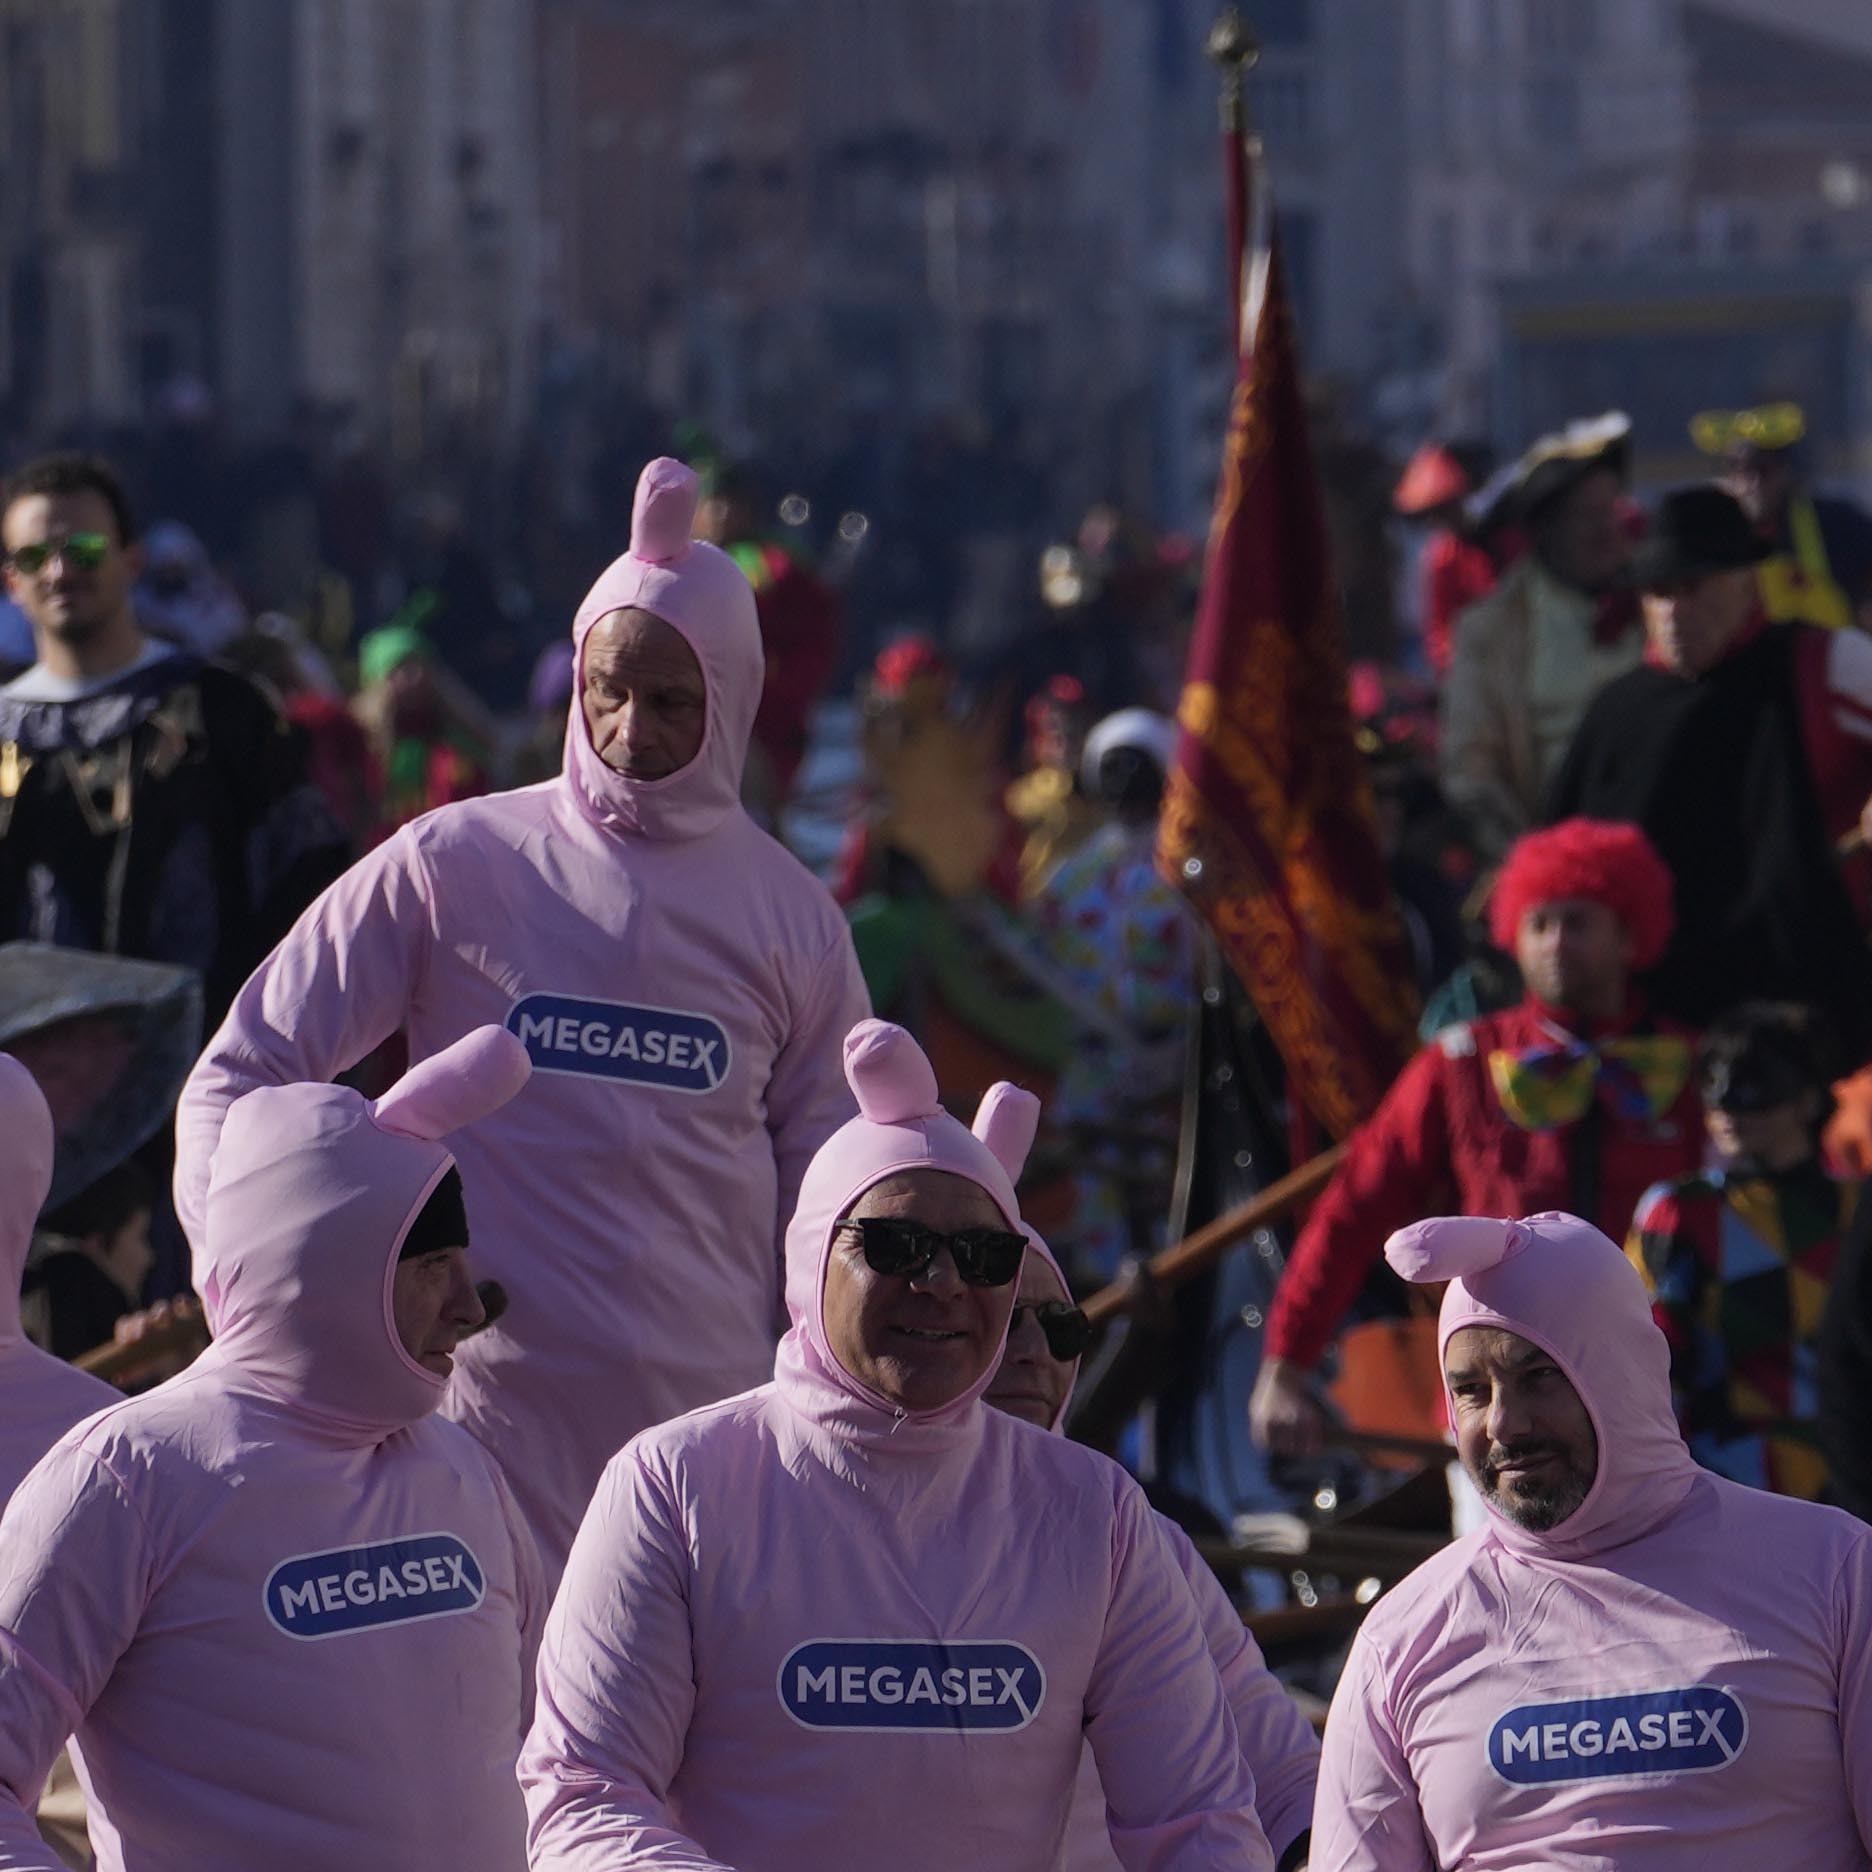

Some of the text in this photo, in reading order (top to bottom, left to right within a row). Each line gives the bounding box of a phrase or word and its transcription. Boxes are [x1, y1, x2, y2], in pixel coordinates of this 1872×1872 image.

[518, 1012, 720, 1088] MEGASEX
[279, 1554, 482, 1619] MEGASEX
[796, 1665, 1033, 1719] MEGASEX
[1501, 1707, 1735, 1765] MEGASEX
